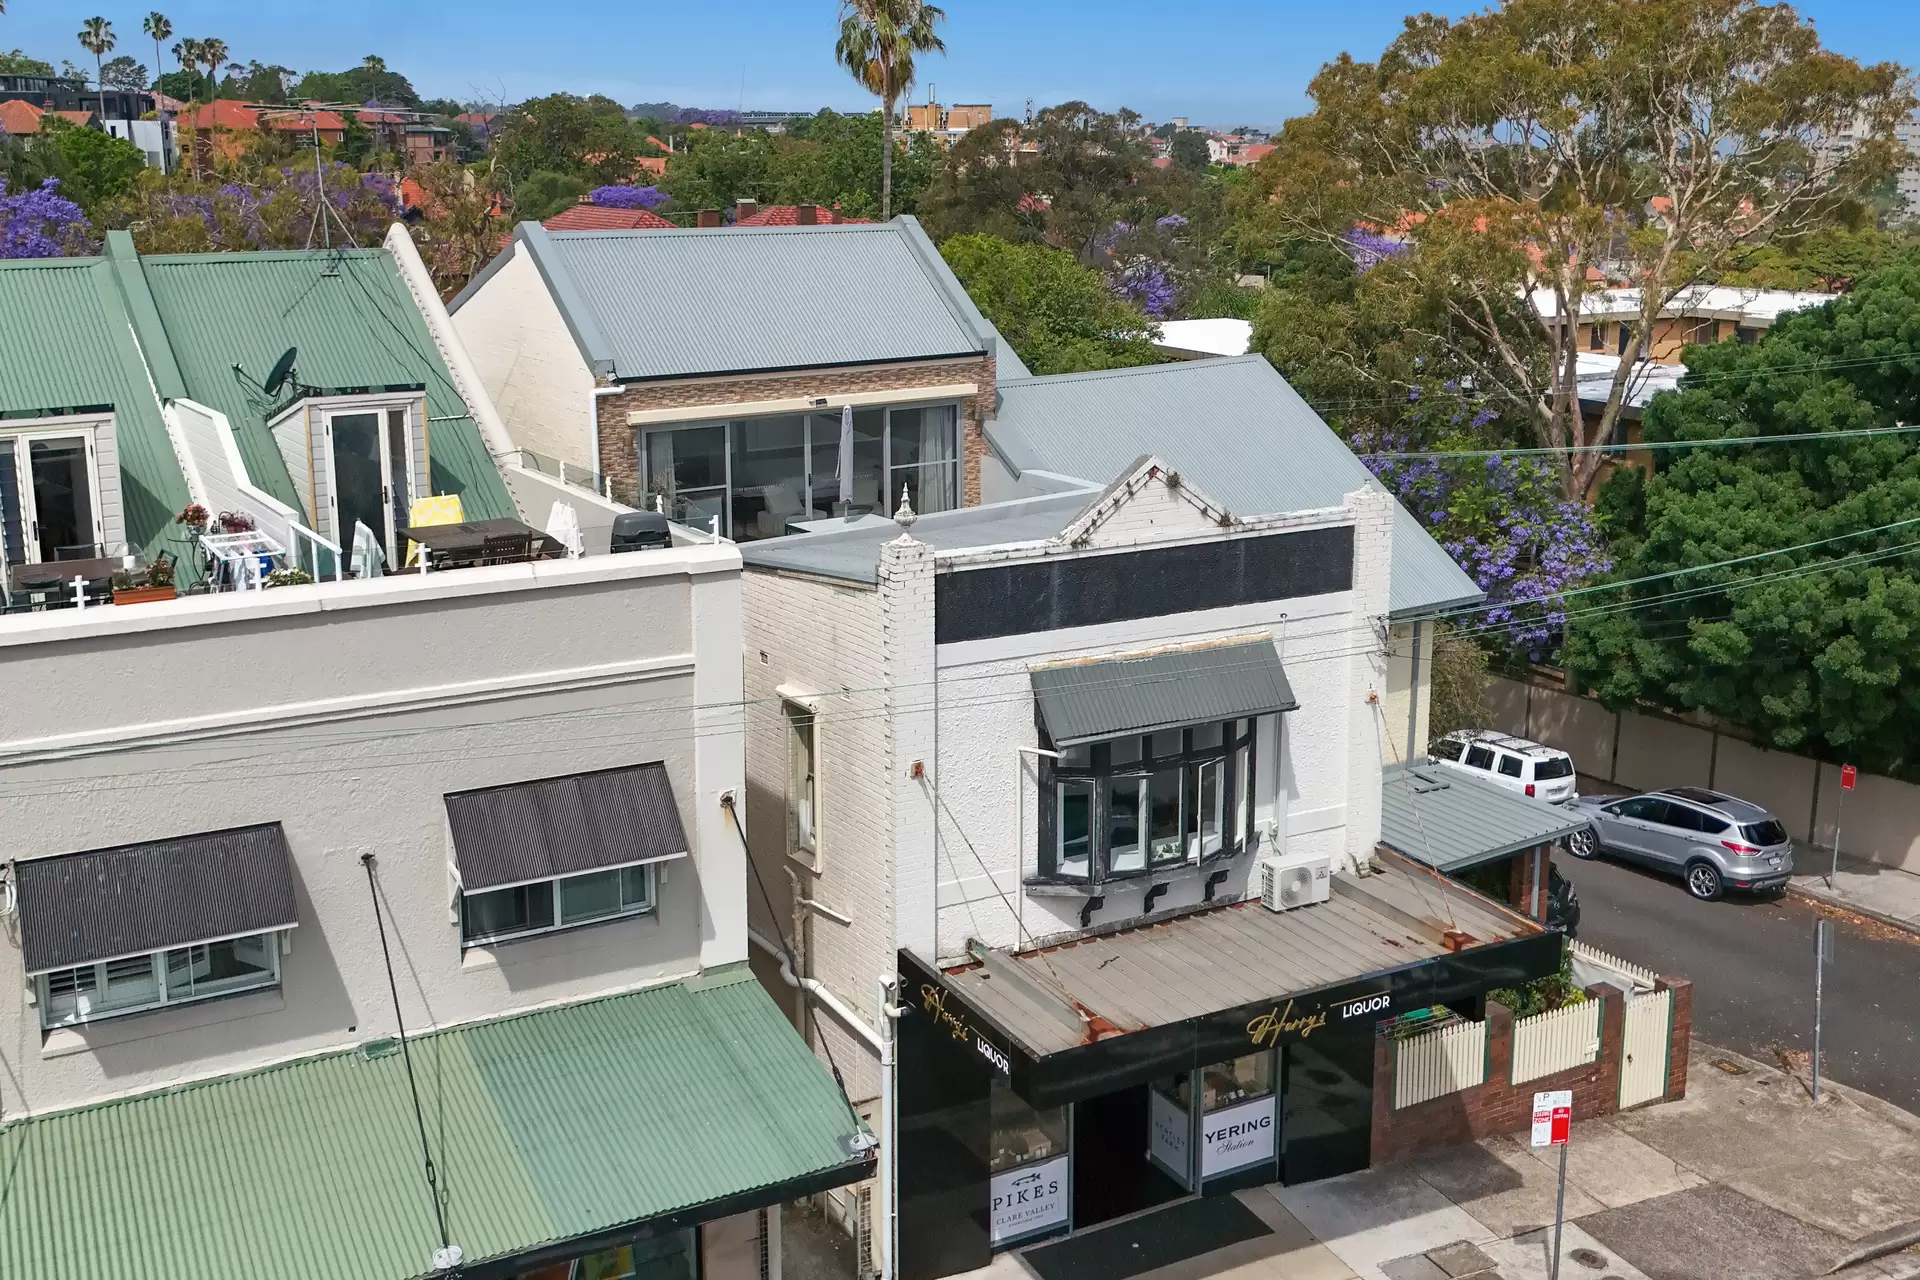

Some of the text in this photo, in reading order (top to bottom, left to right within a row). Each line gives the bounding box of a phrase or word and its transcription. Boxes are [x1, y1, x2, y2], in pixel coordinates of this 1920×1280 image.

[1343, 995, 1390, 1018] LIQUOR
[977, 1037, 1009, 1074] LIQUOR
[1205, 1116, 1271, 1144] YERING
[1216, 1138, 1254, 1156] Station
[992, 1180, 1058, 1211] PIKES
[996, 1211, 1023, 1225] CLARE
[1025, 1202, 1055, 1217] VALLEY
